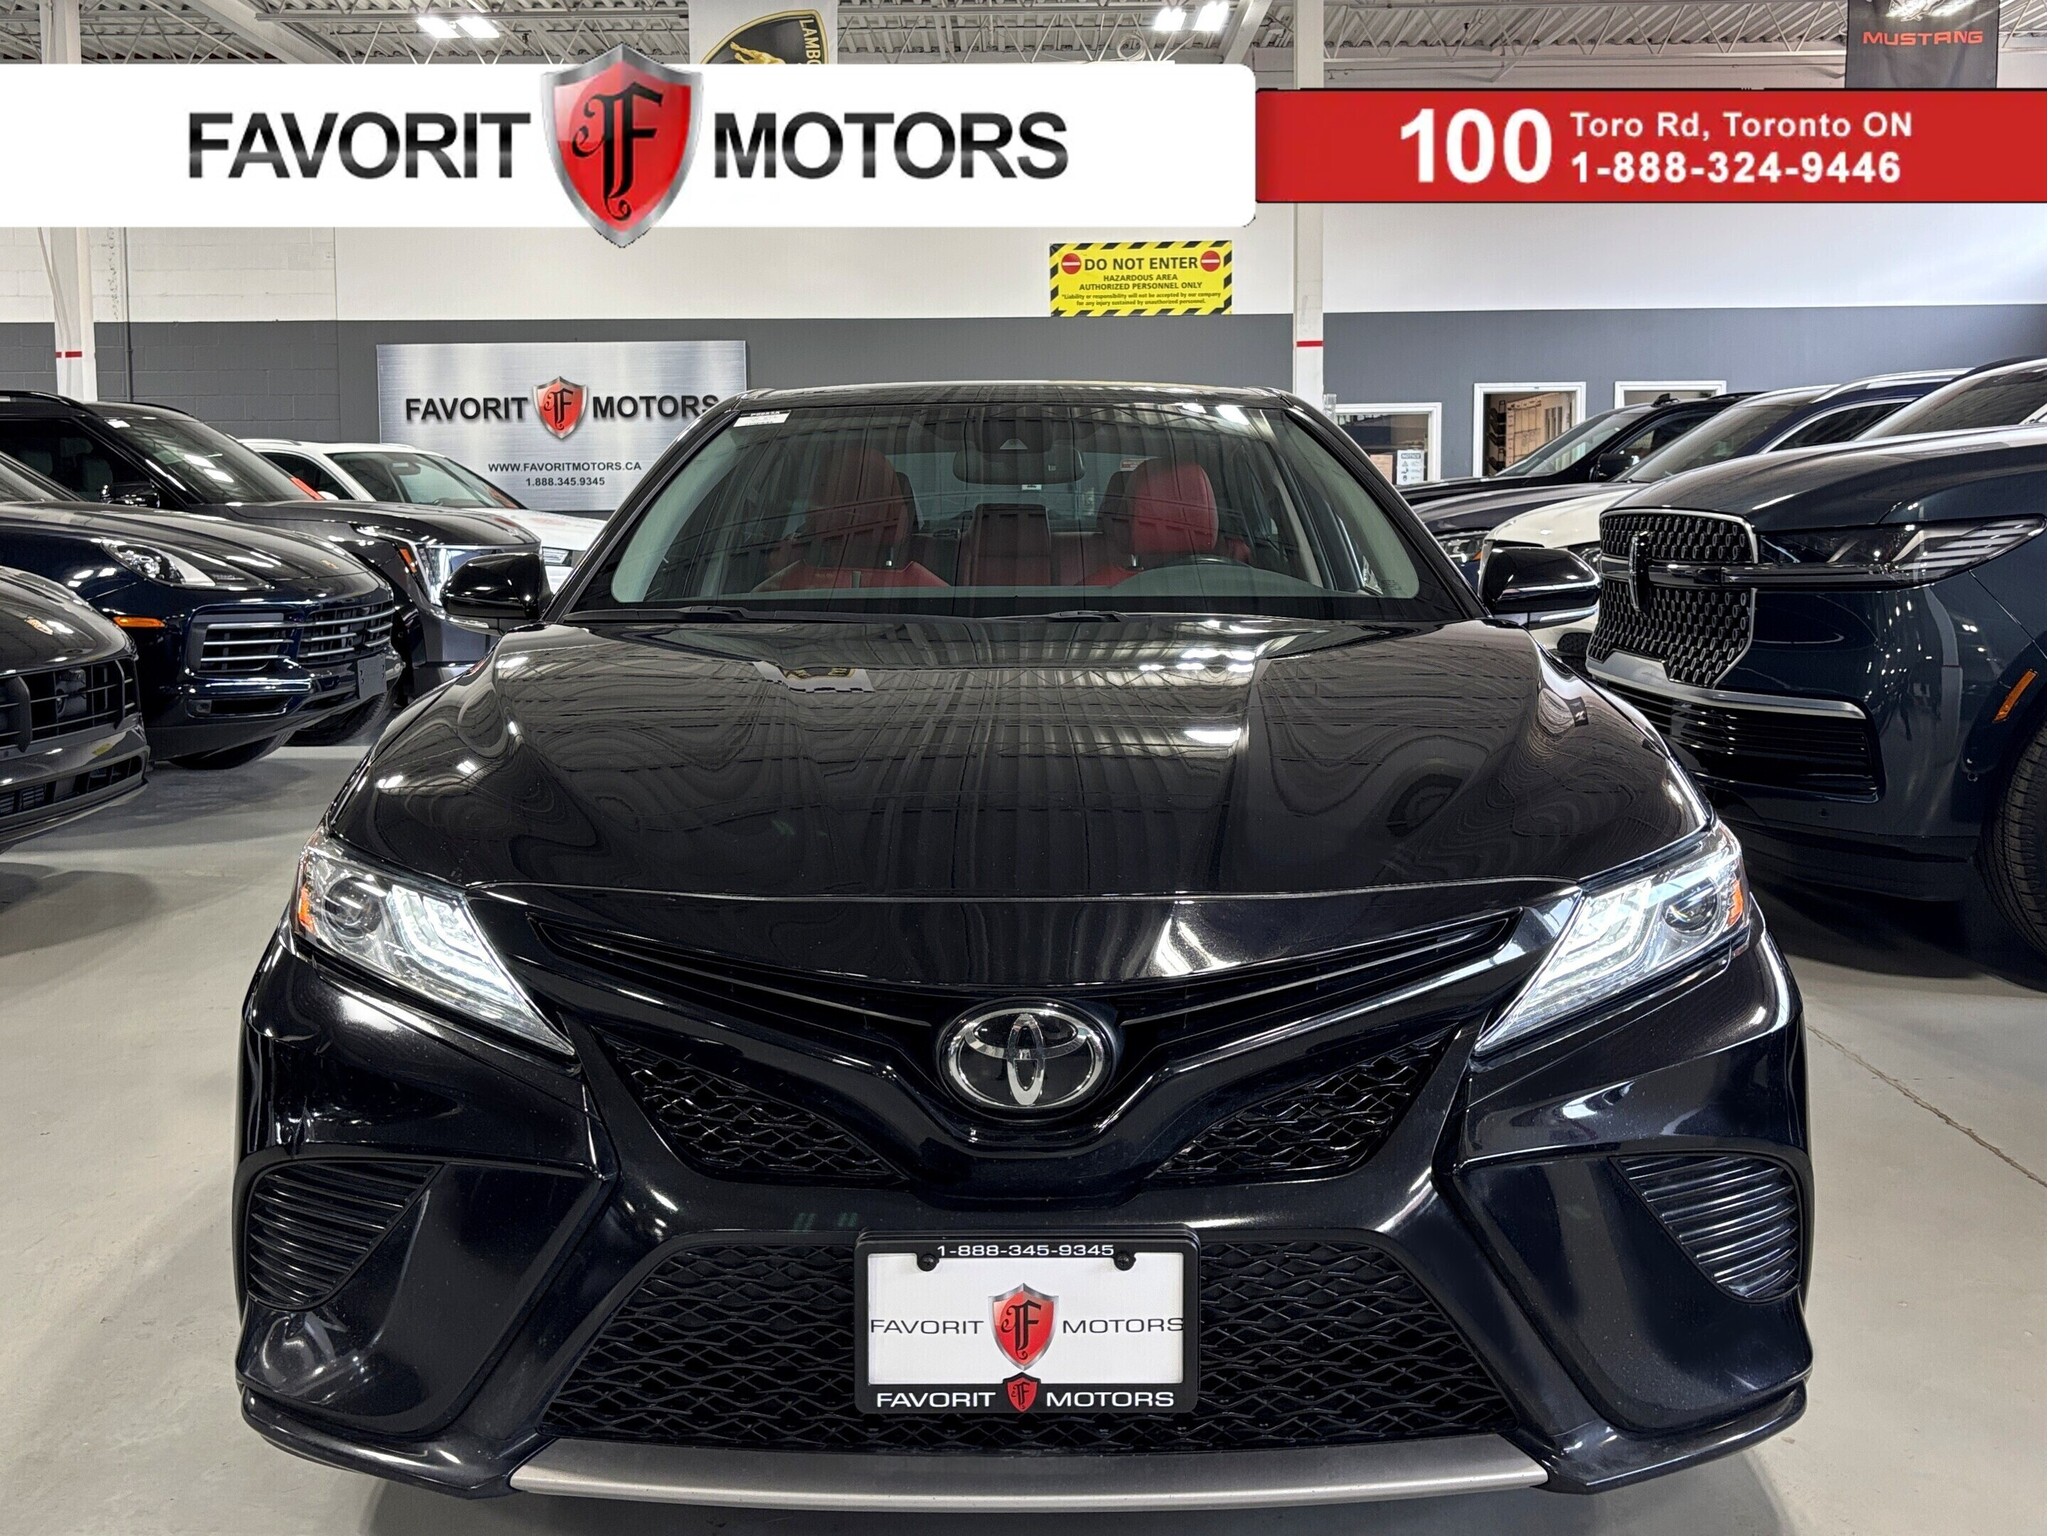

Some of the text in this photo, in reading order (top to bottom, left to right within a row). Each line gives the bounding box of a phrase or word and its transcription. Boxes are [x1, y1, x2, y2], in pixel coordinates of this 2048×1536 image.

[1863, 30, 1984, 46] MUSTANG
[1084, 256, 1199, 271] DO NOT ENTER
[1103, 273, 1179, 282] HAZARDOUS AREA
[1078, 281, 1203, 291] AUTHORIZED PERSONNEL ONLY
[405, 397, 528, 421] FAVORIT
[592, 394, 719, 420] MOTORS
[488, 461, 642, 472] WWW.FAVORITMOTORS.CA
[525, 477, 606, 487] 1.888.345.9345
[937, 1245, 1115, 1257] 1-888-345-9345
[870, 1320, 984, 1335] FAVORIT
[1062, 1317, 1184, 1334] MOTORS
[876, 1392, 996, 1408] FAVORIT
[1046, 1391, 1174, 1408] MOTORS
